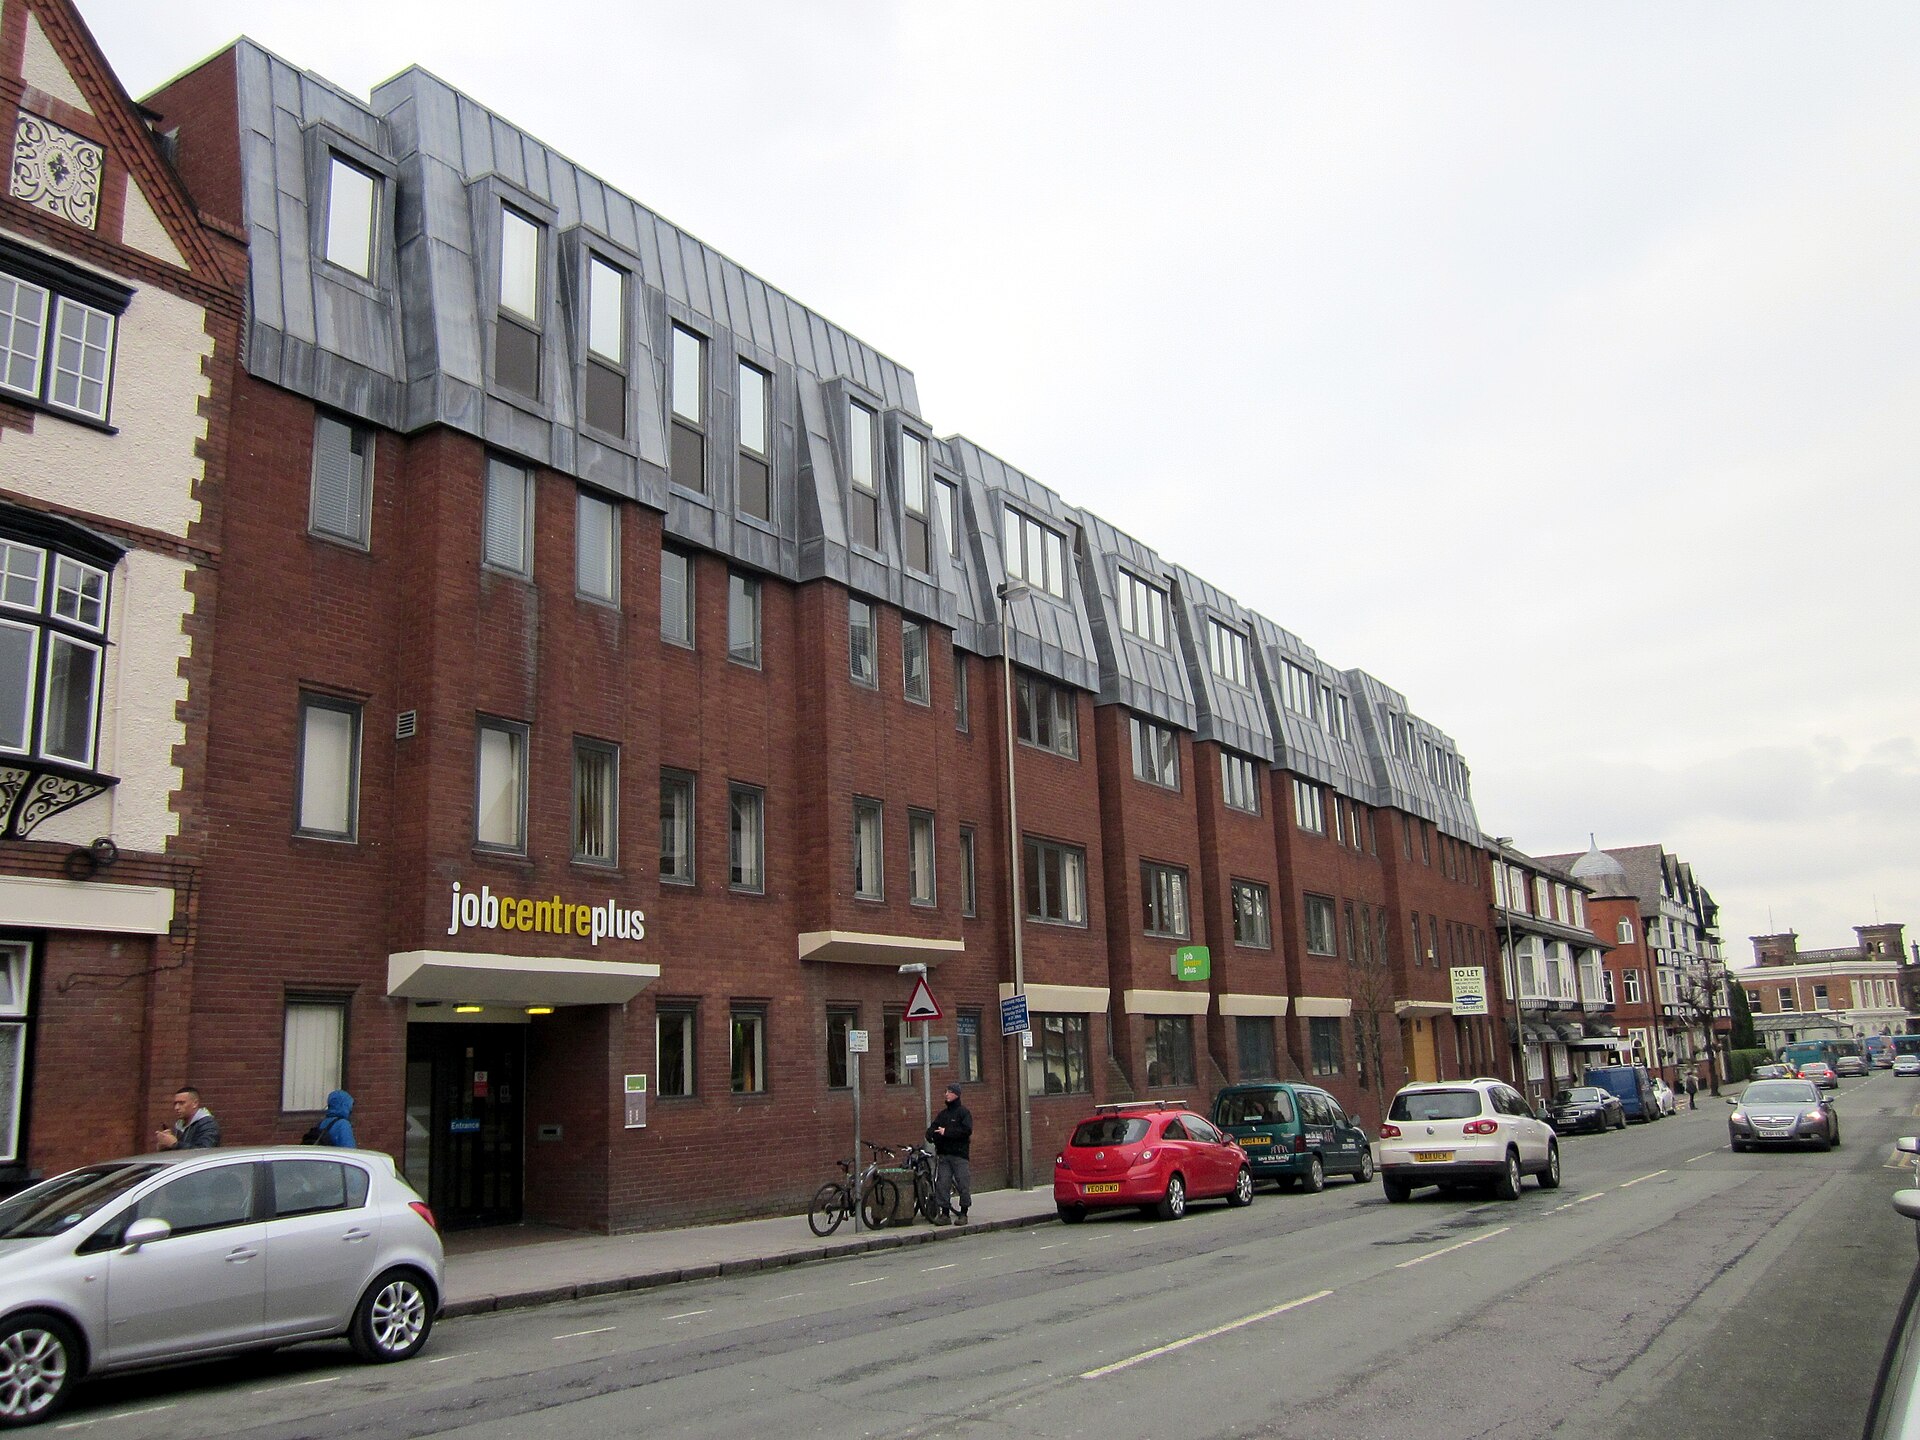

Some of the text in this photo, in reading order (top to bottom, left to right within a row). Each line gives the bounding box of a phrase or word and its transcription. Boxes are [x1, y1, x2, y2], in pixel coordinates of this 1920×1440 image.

[447, 881, 645, 946] jobcentreplus
[1183, 952, 1194, 961] job
[1184, 966, 1197, 975] plus
[451, 1121, 480, 1130] Entrance
